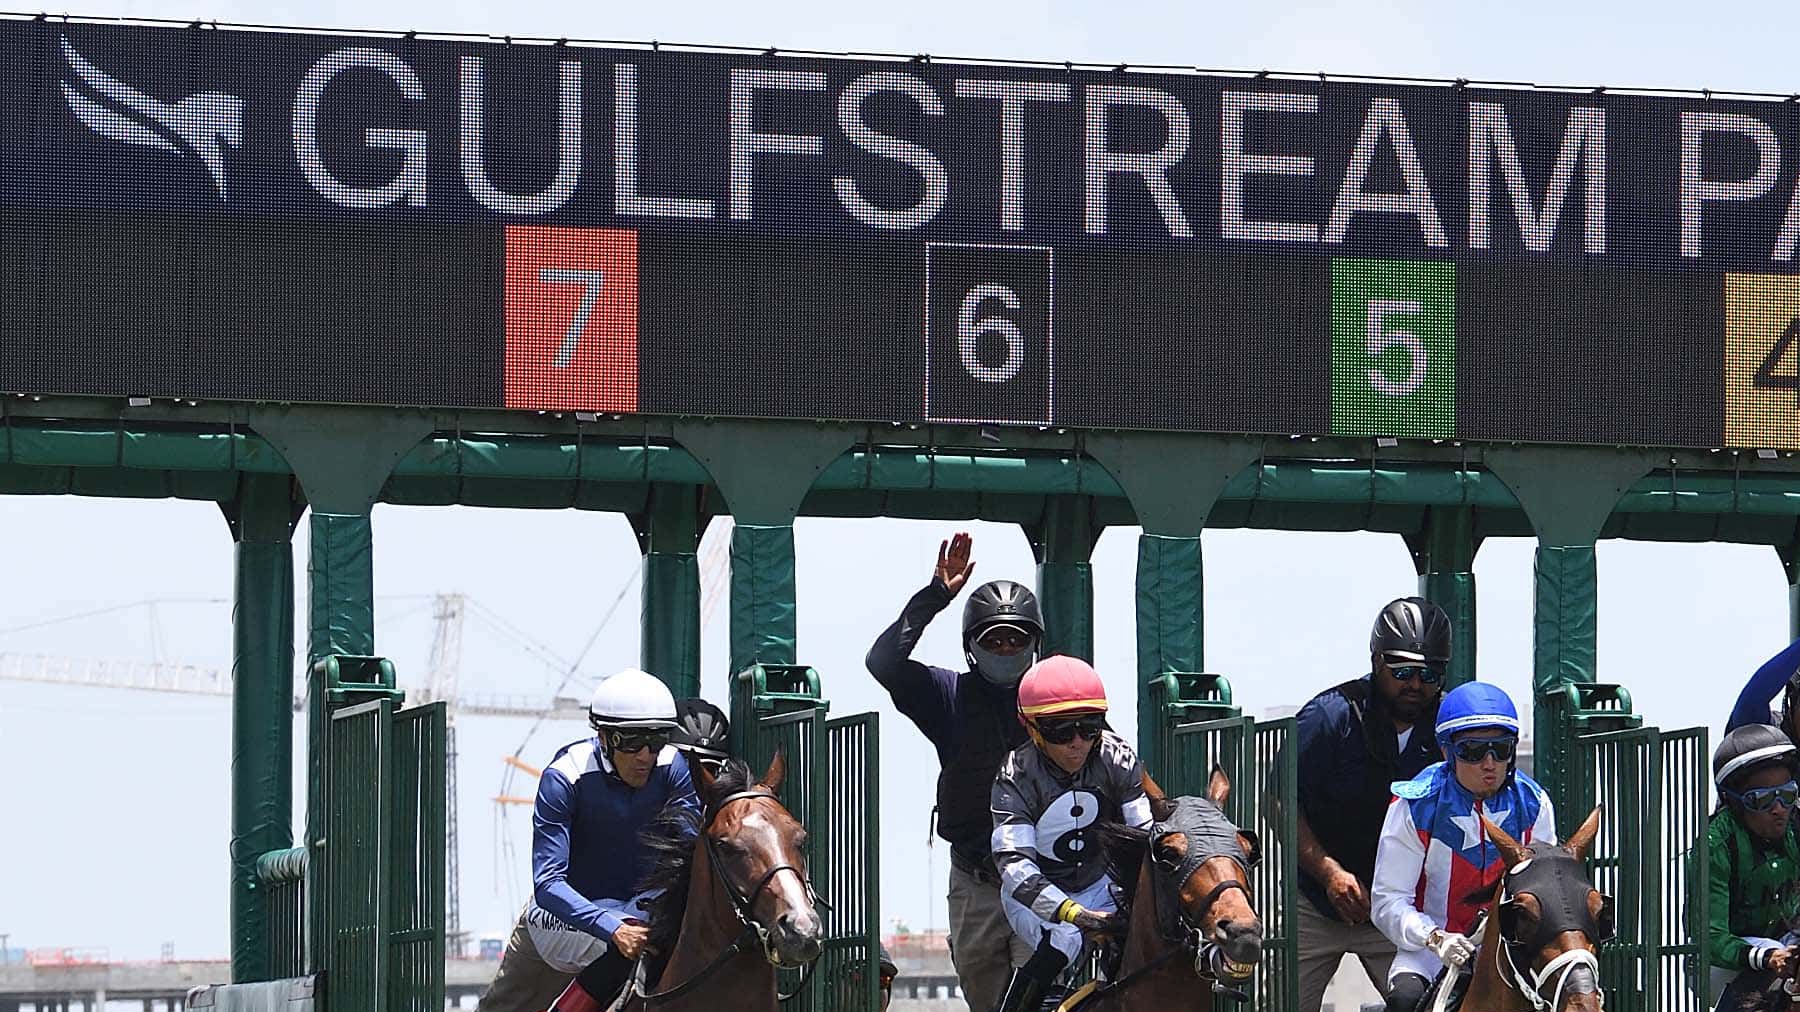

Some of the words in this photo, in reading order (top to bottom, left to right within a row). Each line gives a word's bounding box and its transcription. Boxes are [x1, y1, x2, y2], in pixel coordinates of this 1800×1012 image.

[292, 47, 1607, 254] GULFSTREAM
[538, 267, 605, 369] 7
[957, 283, 1025, 384] 6
[1365, 298, 1429, 398] 5
